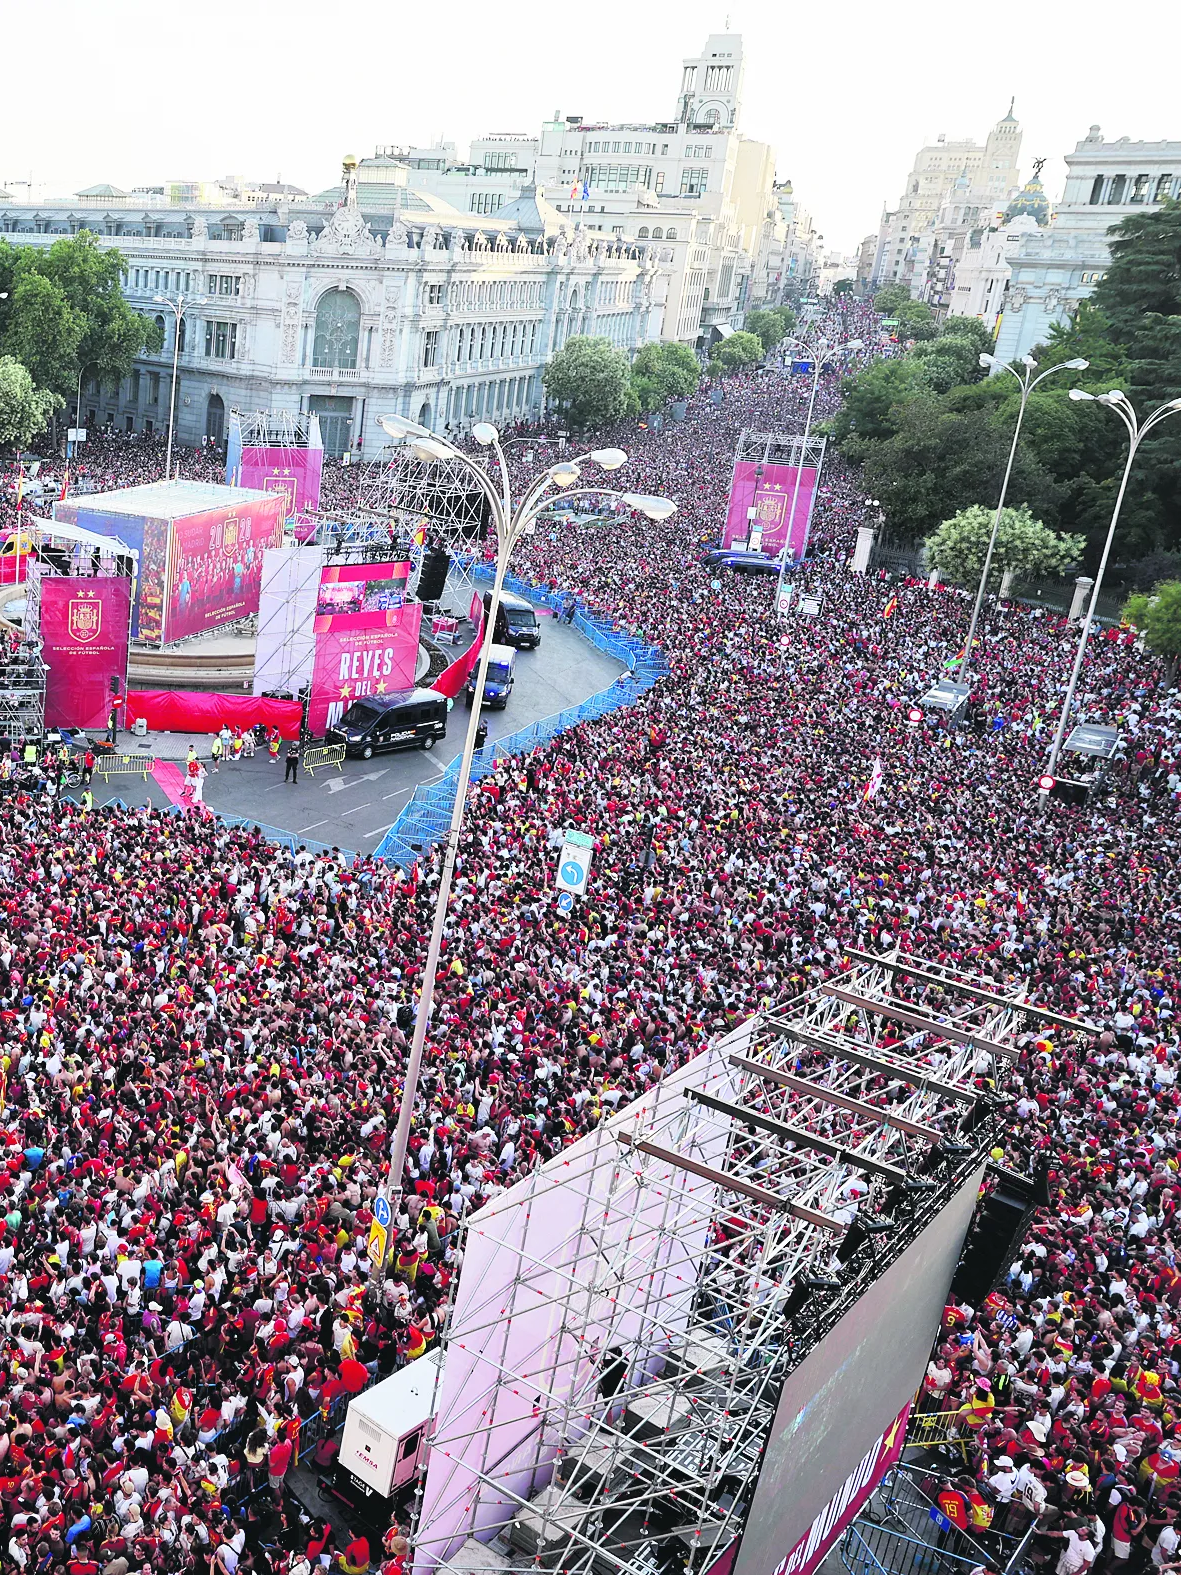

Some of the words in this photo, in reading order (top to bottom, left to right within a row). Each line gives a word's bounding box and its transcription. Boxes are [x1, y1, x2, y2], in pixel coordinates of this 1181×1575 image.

[340, 635, 370, 643] SELECCIÓN
[339, 648, 394, 680] REYES
[354, 681, 372, 697] DEL
[800, 1433, 884, 1572] MUNDO
[944, 1504, 958, 1517] 19
